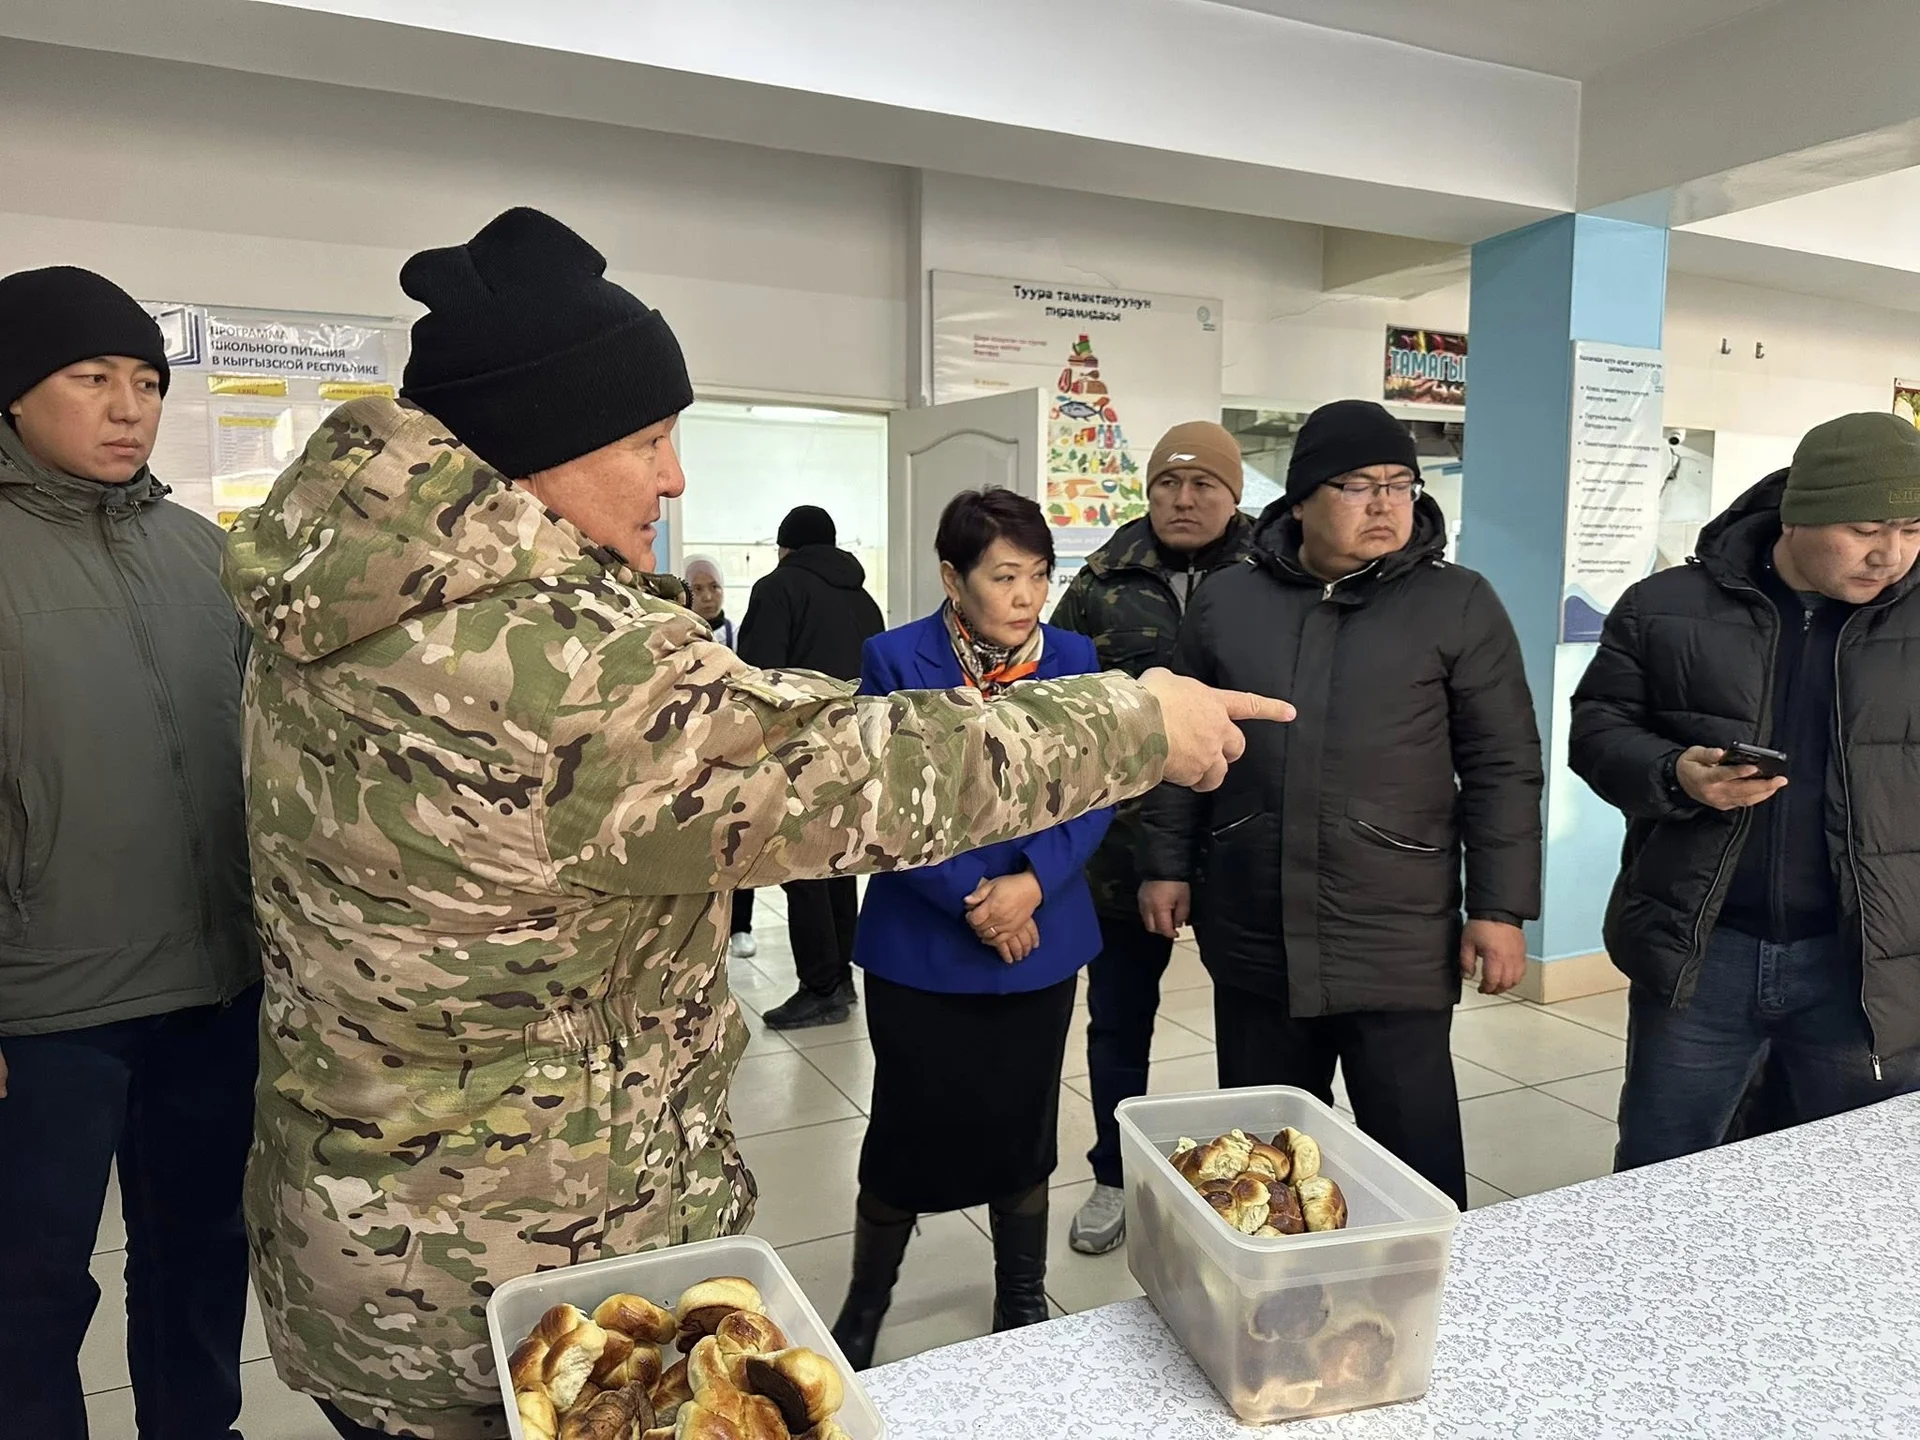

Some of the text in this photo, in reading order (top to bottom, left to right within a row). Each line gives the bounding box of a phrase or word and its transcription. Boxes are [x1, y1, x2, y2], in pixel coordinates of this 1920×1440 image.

[1013, 285, 1152, 310] Туура тамактануунун
[210, 325, 288, 340] ПРОГРАММА
[211, 340, 345, 358] ШКОЛЬНОГО ПИТАНИЯ
[212, 356, 379, 375] В КЫРГЫЗСКОЙ РЕСПУБЛИКЕ
[1390, 349, 1467, 382] ТАМАГЫ
